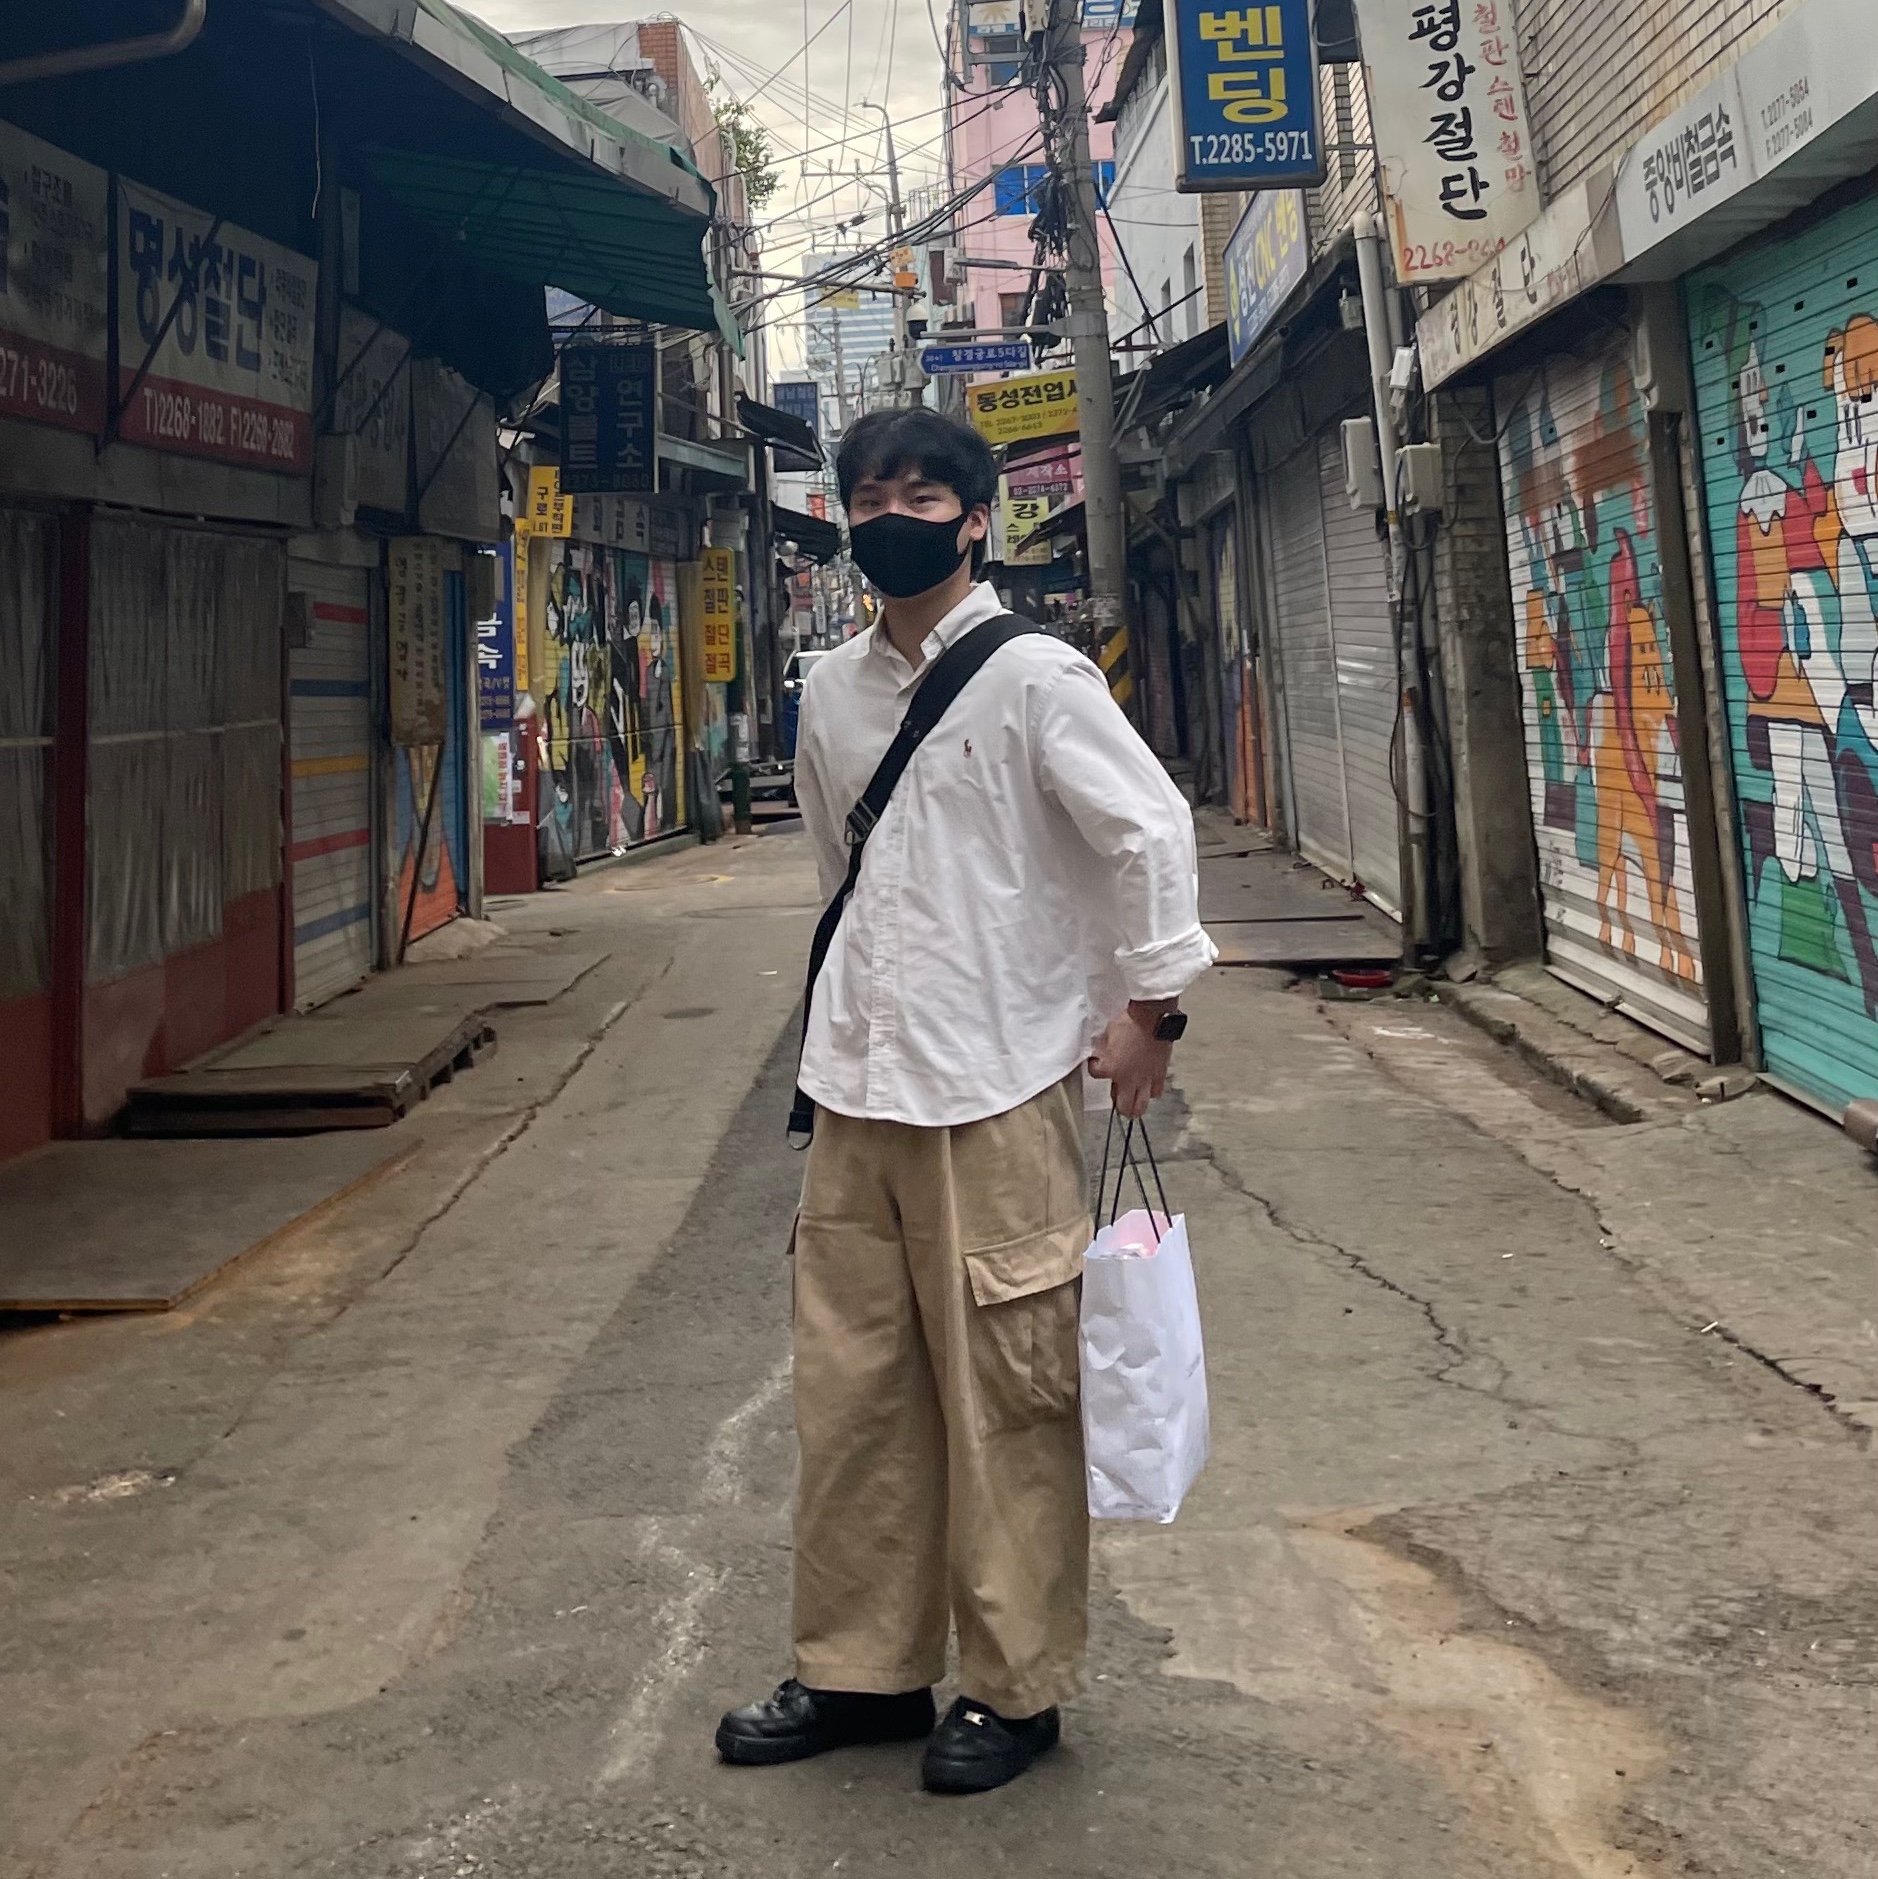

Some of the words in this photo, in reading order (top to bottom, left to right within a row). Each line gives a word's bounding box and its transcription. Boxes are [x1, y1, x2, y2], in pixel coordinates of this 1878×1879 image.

[1199, 6, 1289, 124] 벤딩
[1408, 0, 1490, 220] 평강절단
[1190, 131, 1313, 165] T.2285-5971
[1642, 102, 1737, 223] 중앙비철금속
[616, 379, 644, 468] 연구소
